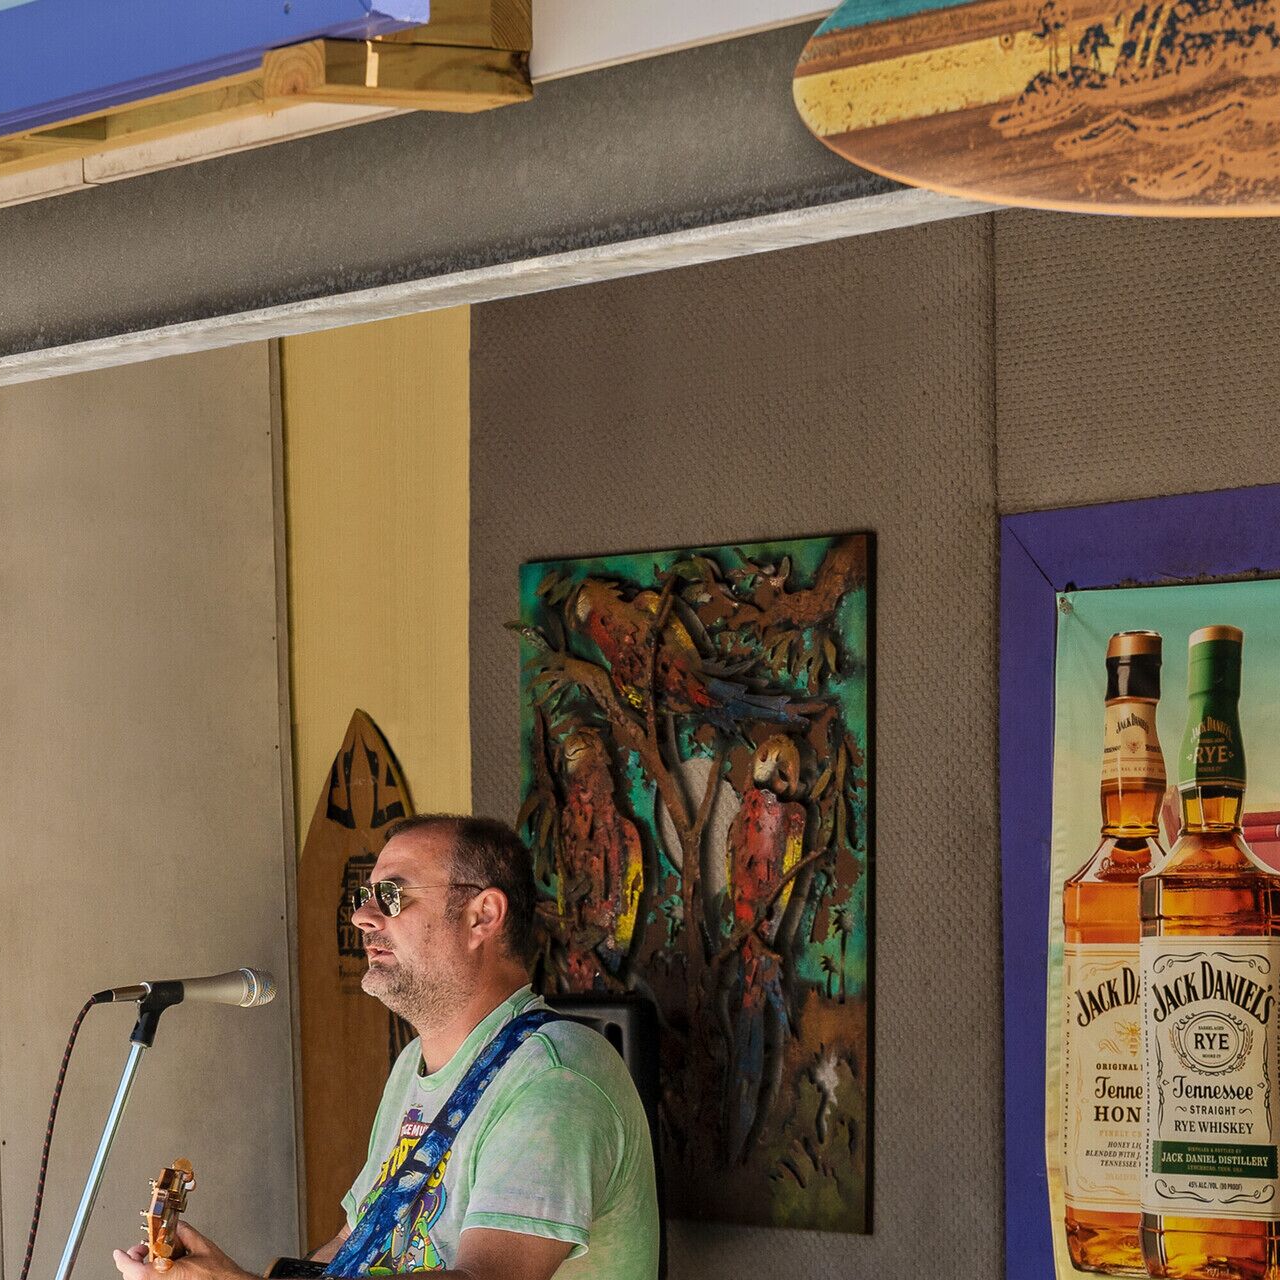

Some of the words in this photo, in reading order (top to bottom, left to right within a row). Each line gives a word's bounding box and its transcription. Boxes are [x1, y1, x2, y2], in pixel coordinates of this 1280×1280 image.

[1193, 745, 1228, 764] RYE
[1151, 971, 1200, 1023] JACK
[1200, 960, 1276, 1025] DANIEL'S
[1074, 978, 1122, 1027] JACK
[1194, 1032, 1229, 1050] RYE
[1095, 1063, 1139, 1071] ORIGINAL
[1094, 1076, 1143, 1099] Tenne
[1172, 1075, 1254, 1100] Tennessee
[1094, 1105, 1141, 1123] HON
[1190, 1105, 1236, 1116] STRAIGHT
[1174, 1120, 1196, 1133] RYE
[1198, 1121, 1254, 1135] WHISKEY
[1085, 1149, 1117, 1158] BLENDED
[1161, 1152, 1186, 1162] JACK
[1186, 1153, 1217, 1164] DANIEL
[1218, 1155, 1268, 1167] DISTILLERY
[1100, 1159, 1137, 1168] TENNESSEE
